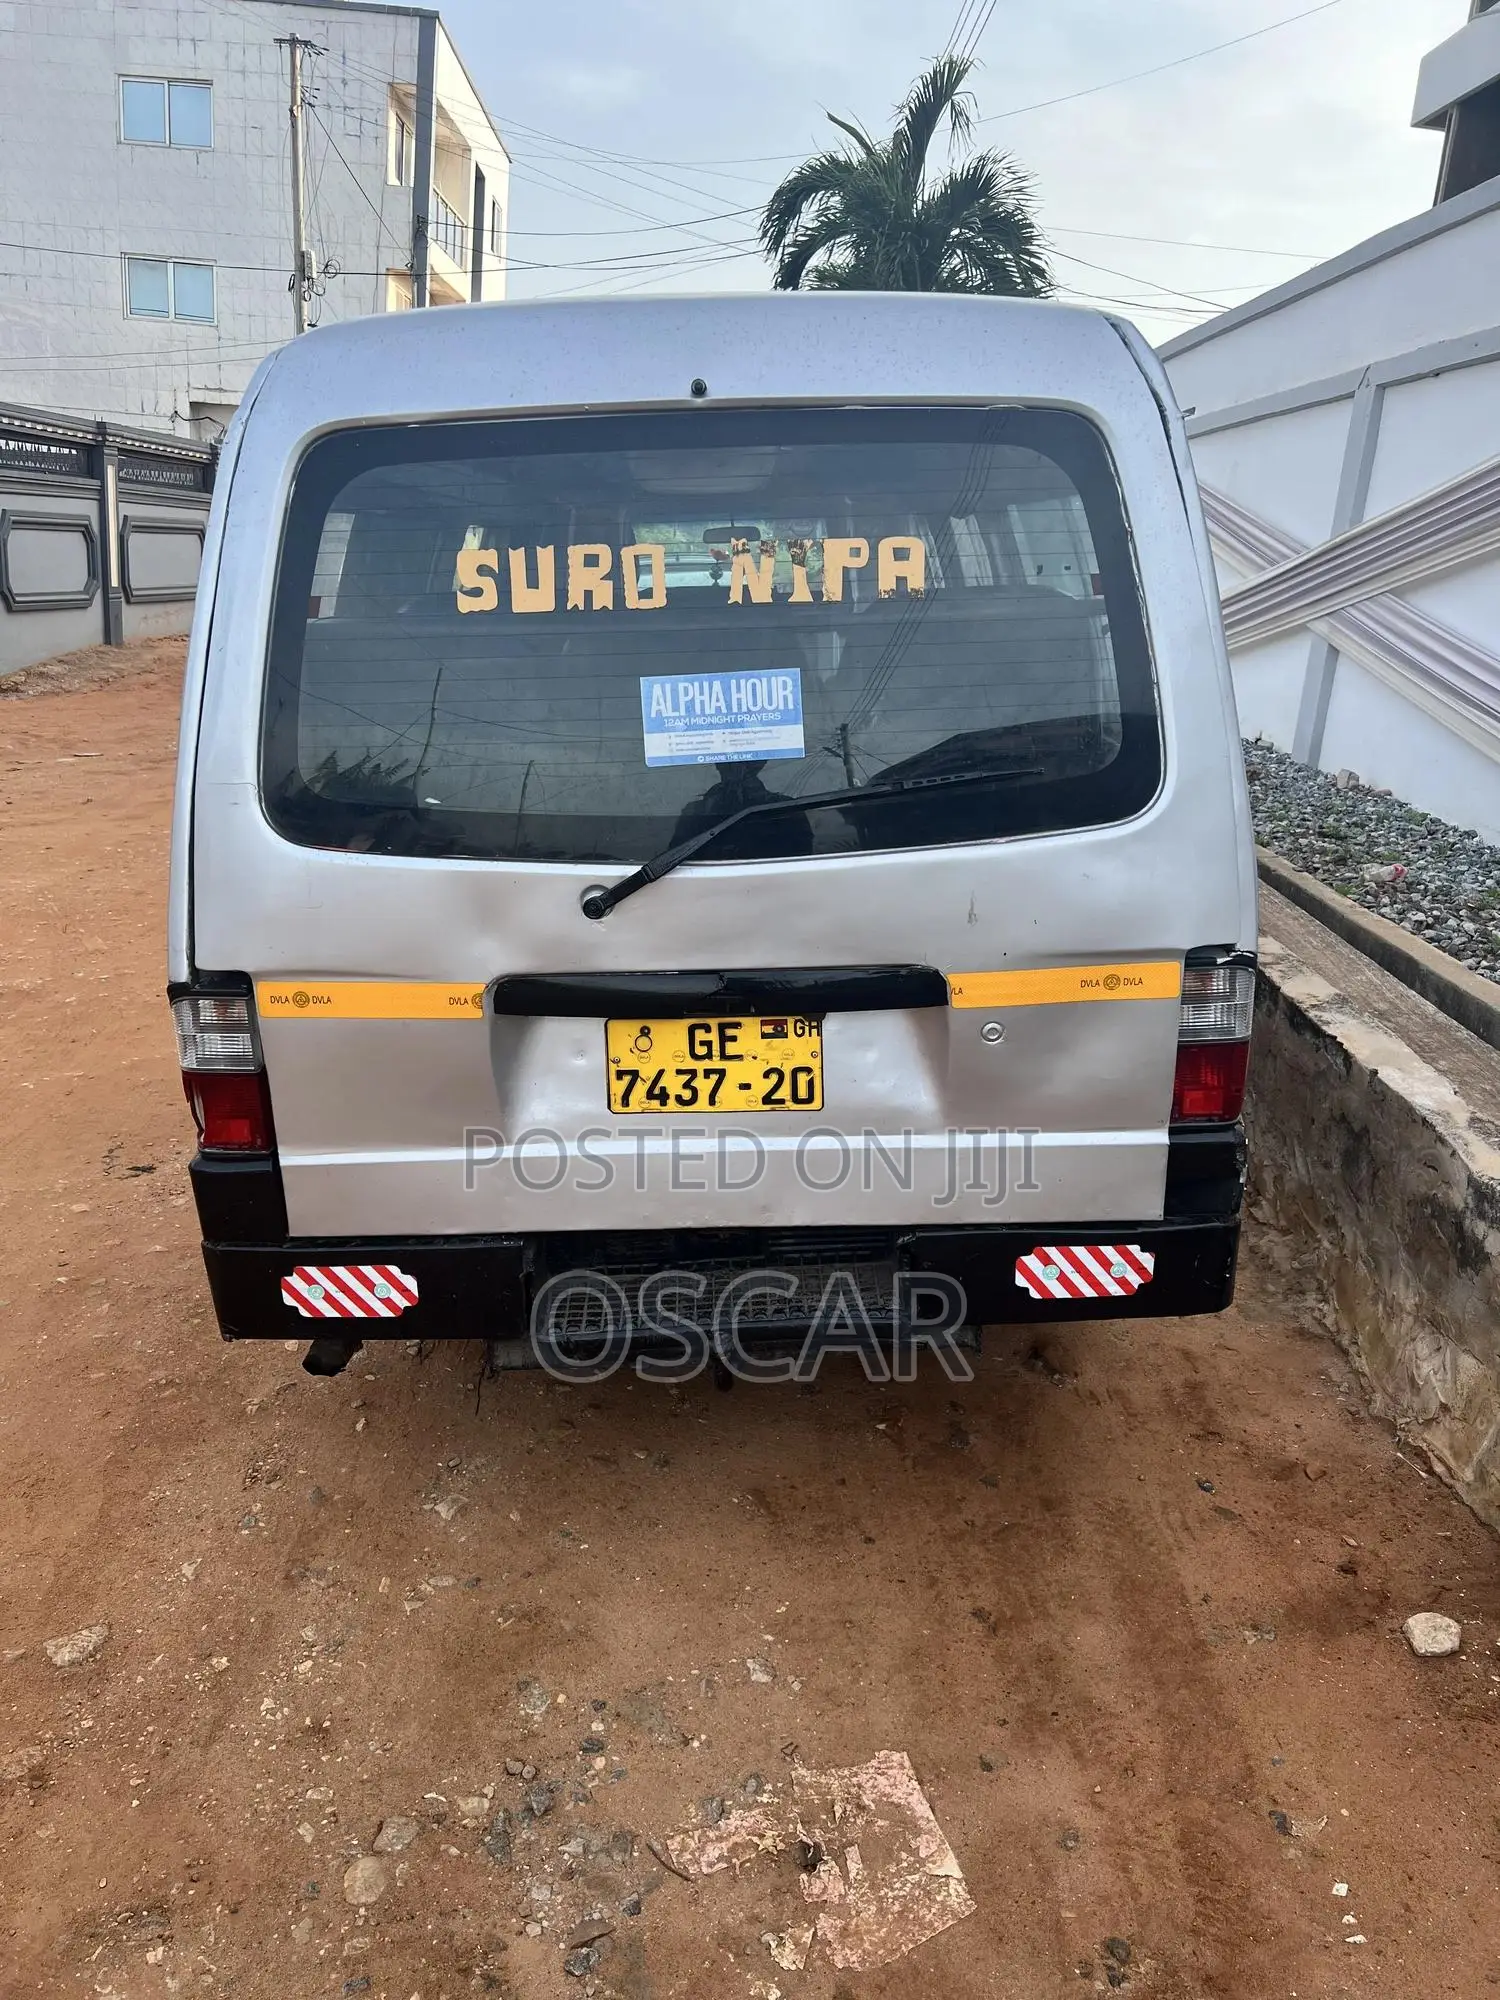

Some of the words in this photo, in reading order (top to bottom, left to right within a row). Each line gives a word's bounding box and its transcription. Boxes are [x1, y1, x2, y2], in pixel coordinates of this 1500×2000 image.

[457, 543, 667, 614] SURO
[728, 536, 926, 605] NIPA
[651, 679, 728, 718] ALPHA
[730, 676, 795, 713] HOUR
[664, 717, 689, 727] 12AM
[691, 714, 736, 726] MIDNIGHT
[738, 711, 782, 723] PRAYERS
[1080, 979, 1100, 988] DVLA
[1123, 977, 1143, 987] DVLA
[270, 995, 290, 1004] DVLA
[312, 995, 332, 1004] DVLA
[449, 996, 469, 1005] DVLA
[688, 1022, 743, 1061] GE
[794, 1018, 820, 1037] GH
[616, 1066, 815, 1107] 7437-20
